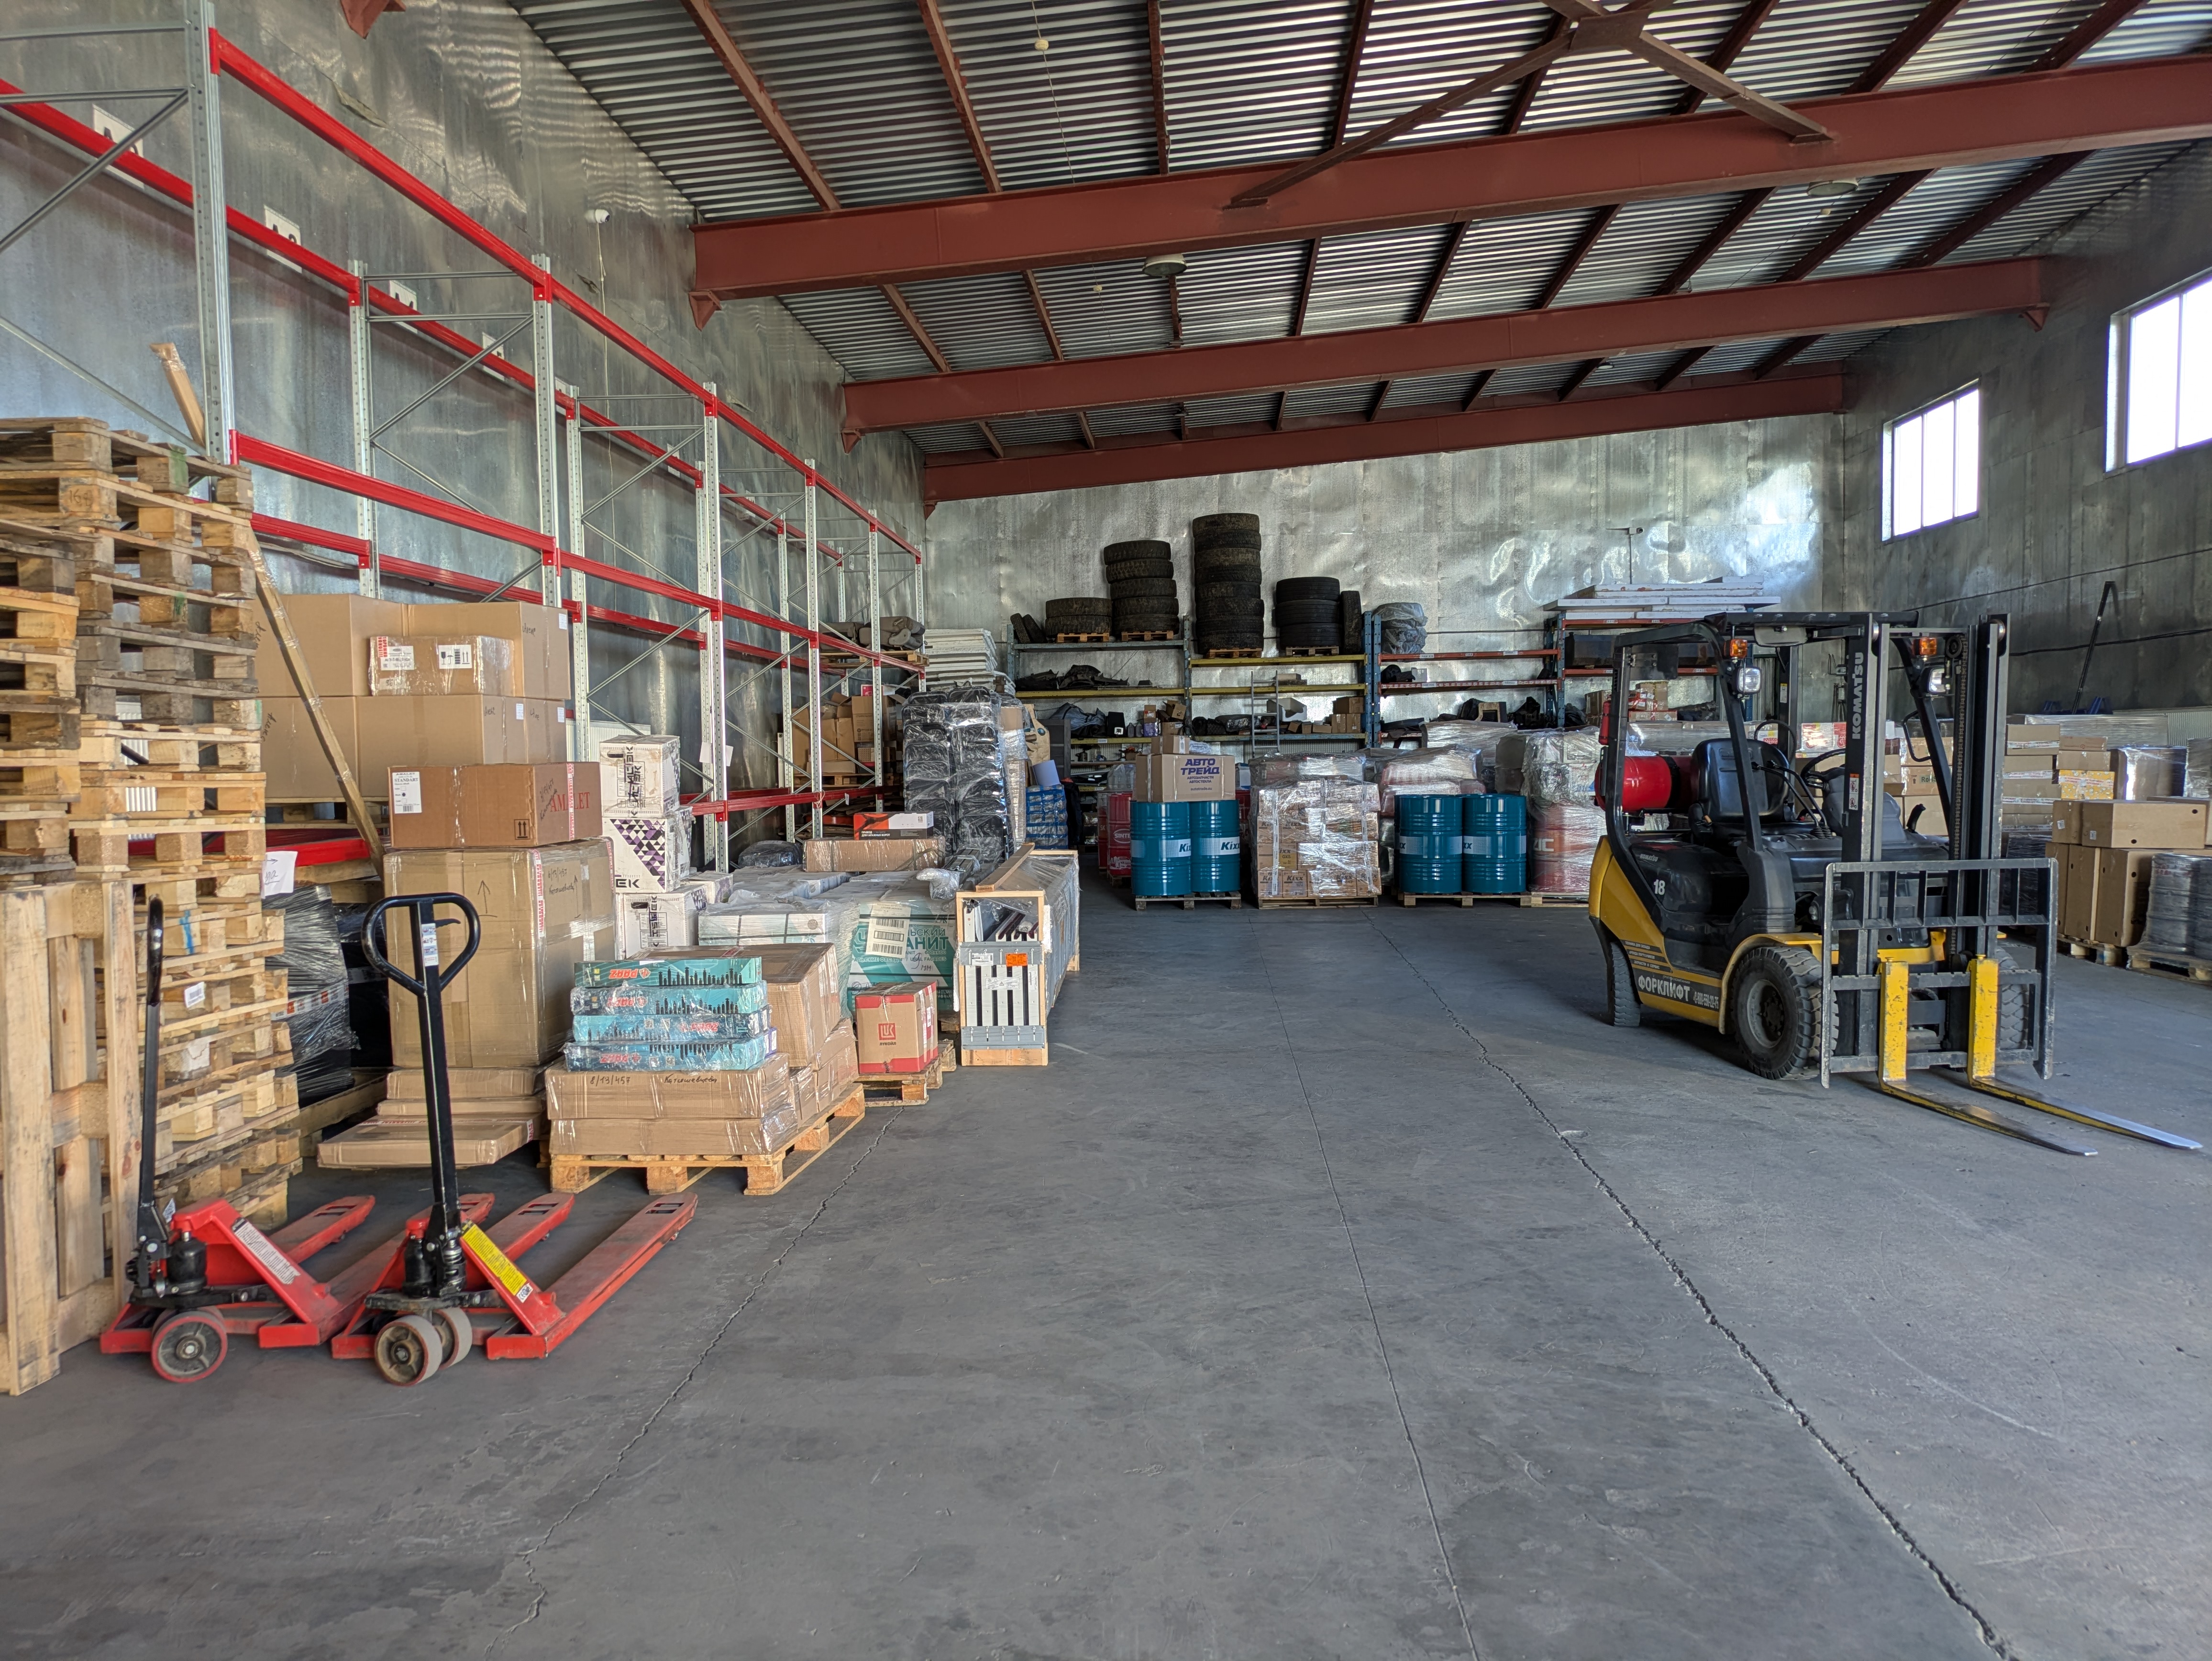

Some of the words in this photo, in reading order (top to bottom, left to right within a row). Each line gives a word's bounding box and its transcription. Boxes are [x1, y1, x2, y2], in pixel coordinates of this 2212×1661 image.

[1852, 652, 1864, 739] KOMATSU
[1180, 765, 1220, 775] ТРЕЙД
[550, 792, 590, 812] AMLET
[1179, 843, 1192, 853] Kix
[1639, 853, 1659, 862] KOMATSU
[1654, 879, 1665, 895] 18
[909, 927, 946, 937] ЬСКИЙ
[906, 936, 949, 950] АНИТ
[1638, 975, 1690, 1002] ФОРКЛИФТ
[590, 1074, 630, 1087] 8/13/457
